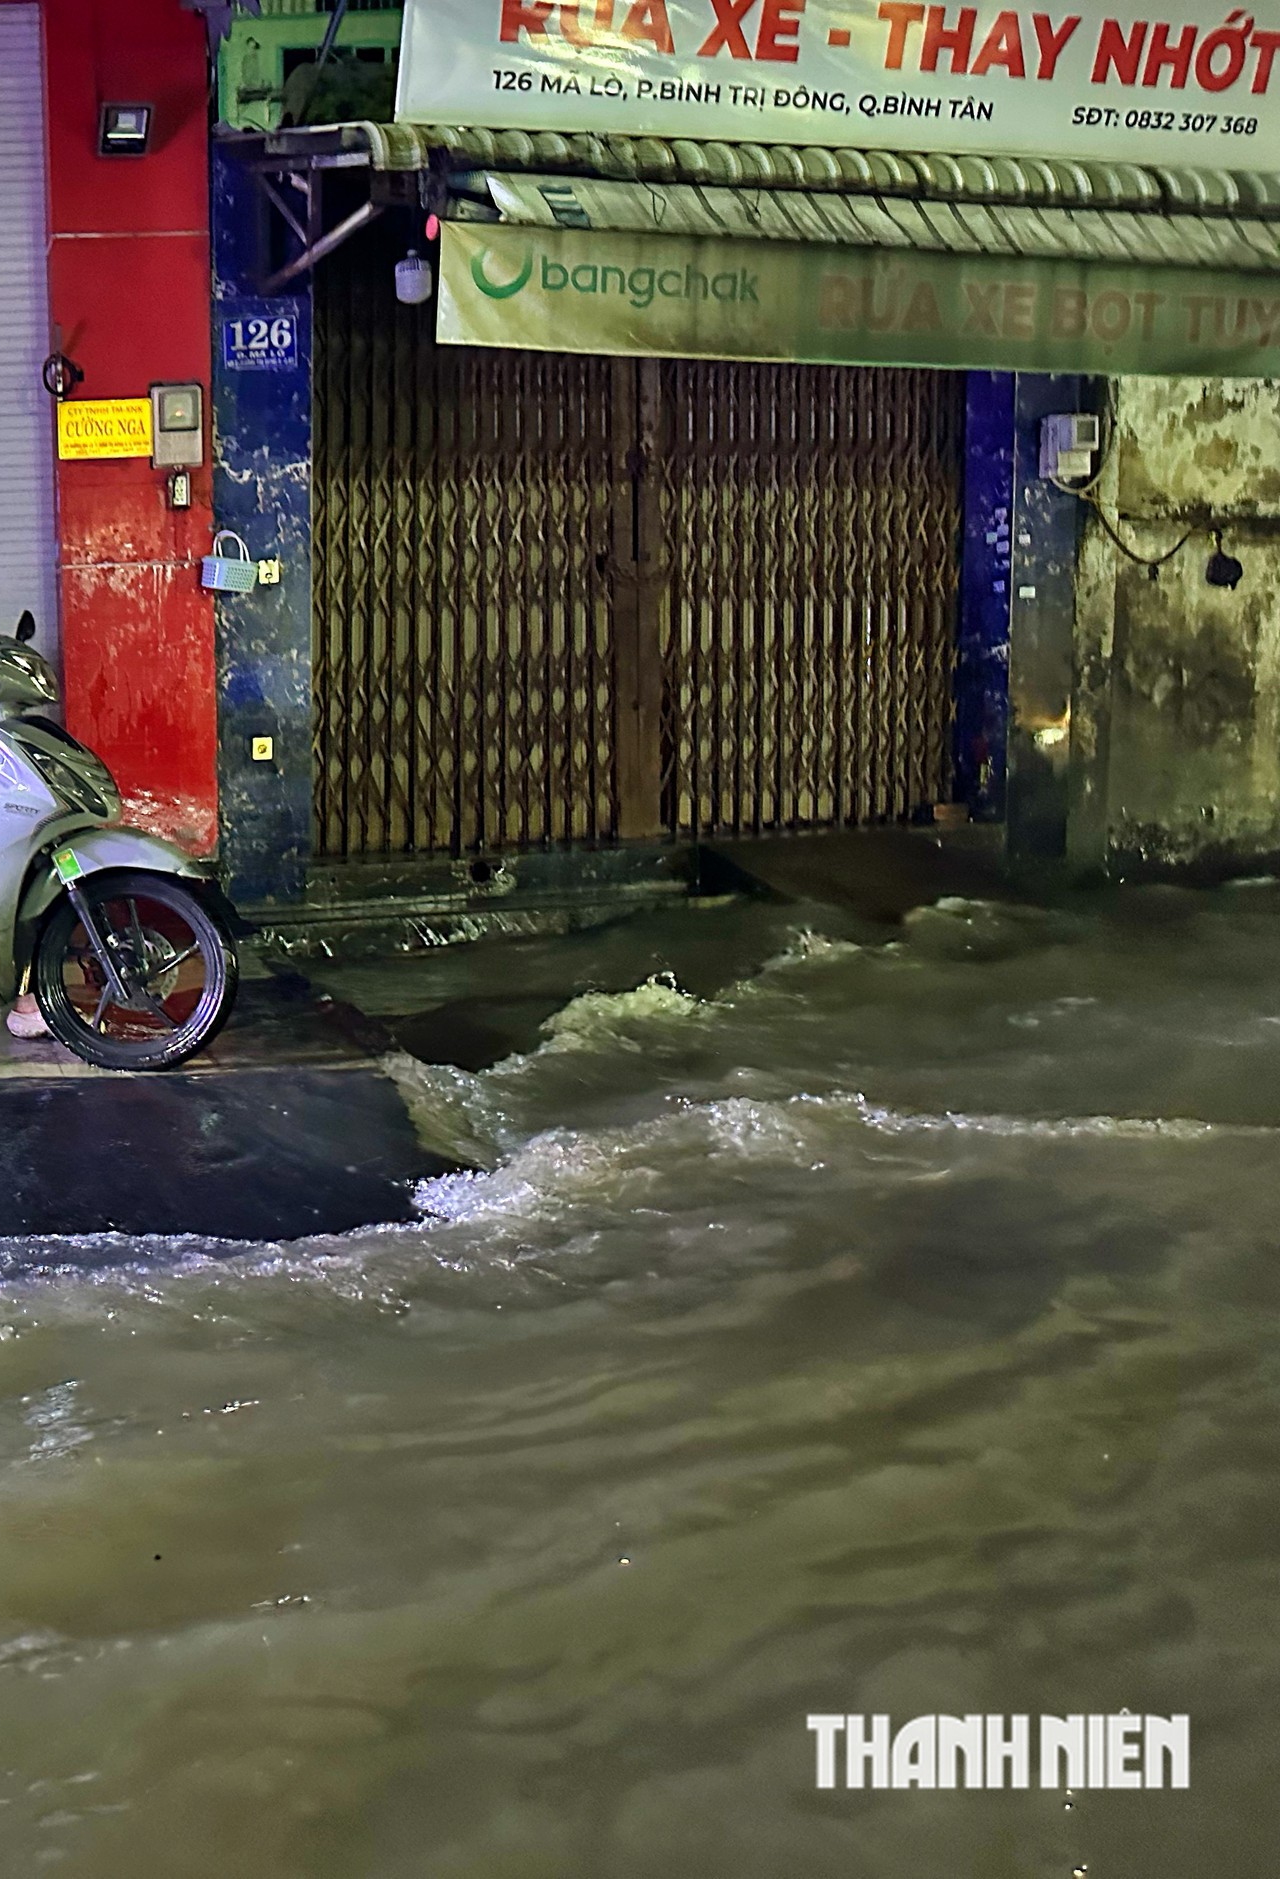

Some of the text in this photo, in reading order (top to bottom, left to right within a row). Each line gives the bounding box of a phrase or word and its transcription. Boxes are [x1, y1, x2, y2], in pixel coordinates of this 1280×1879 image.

[696, 0, 806, 64] XE
[878, 2, 1082, 80] THAY
[1090, 8, 1280, 95] NHỚT
[492, 69, 994, 121] 126 MÃ LÒ, P.BÌNH TRỊ ĐÔNG, Q.BÌNH TÂN
[1072, 106, 1260, 136] SĐT: 0832 307 368
[540, 254, 762, 309] bangchak
[230, 318, 292, 350] 126
[962, 280, 1038, 340] XE
[1050, 287, 1167, 356] BỌT
[66, 416, 146, 437] CƯỜNG NGA
